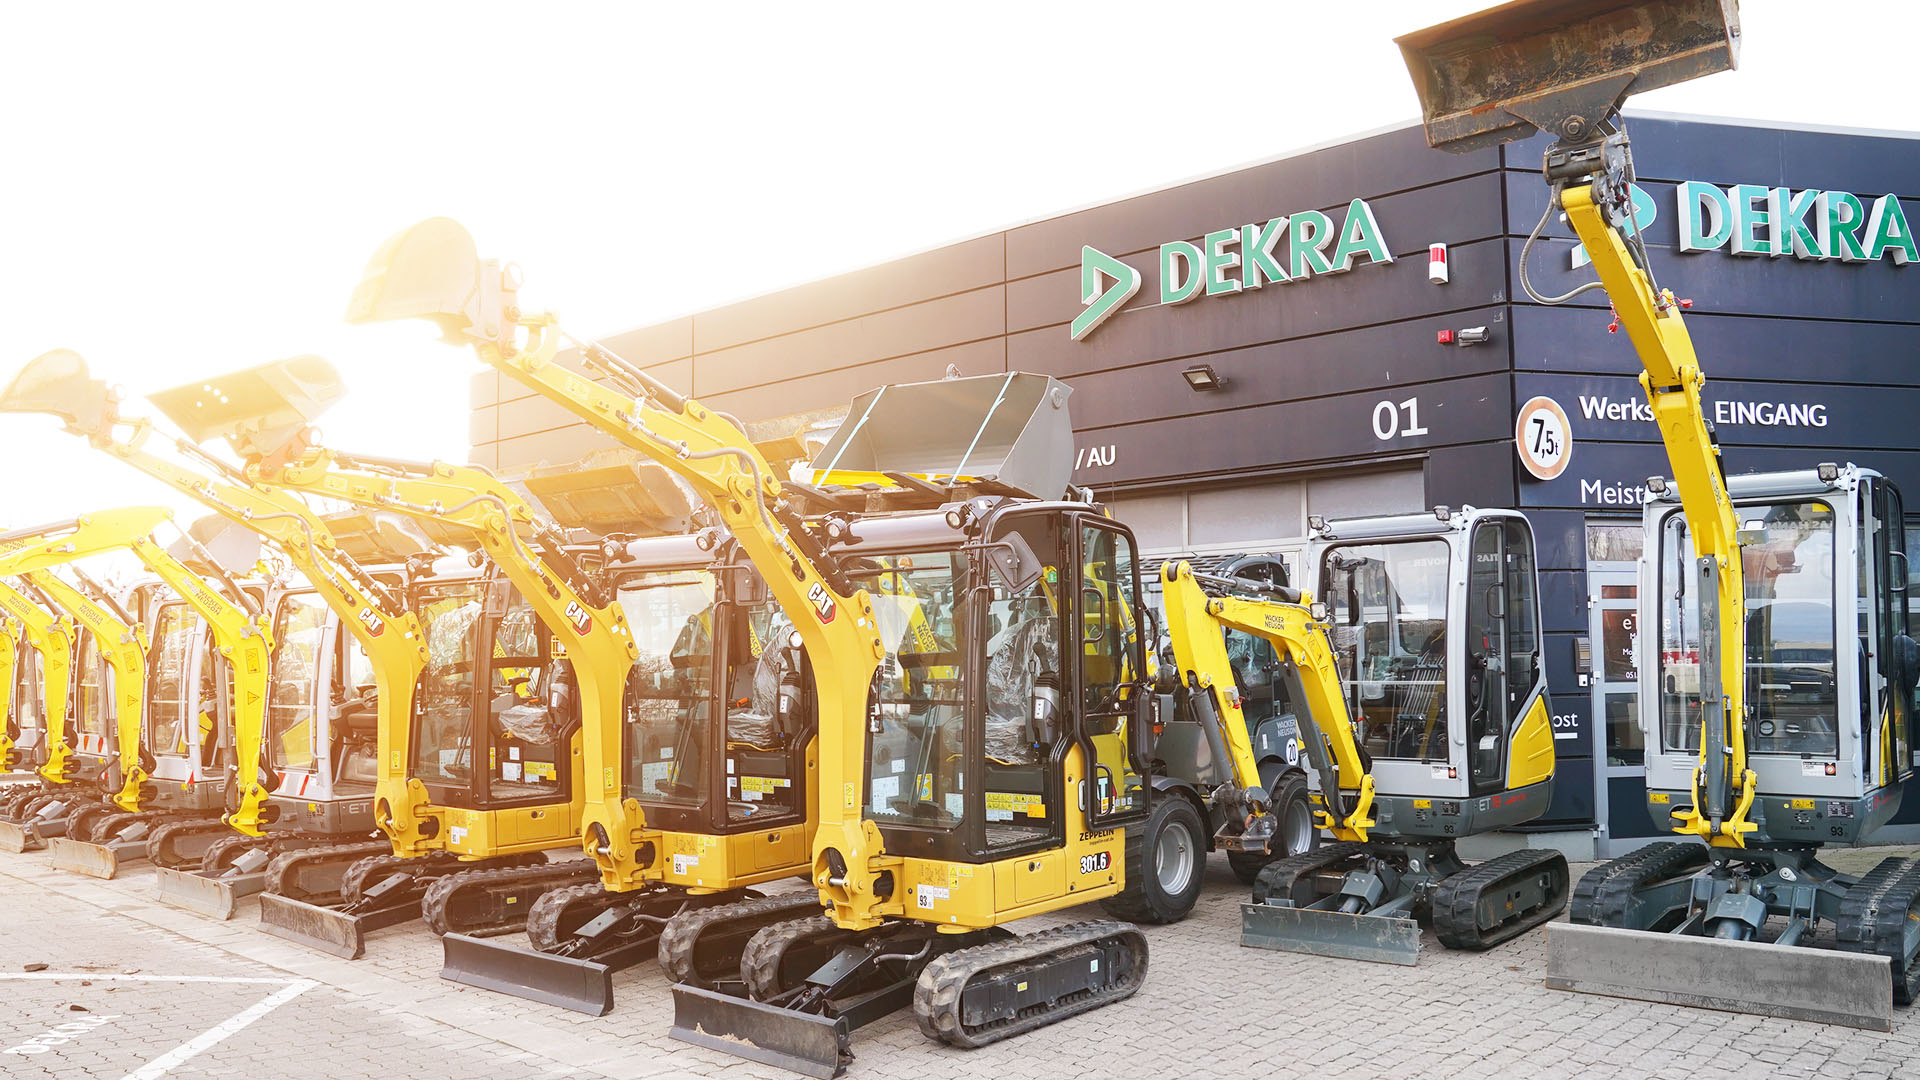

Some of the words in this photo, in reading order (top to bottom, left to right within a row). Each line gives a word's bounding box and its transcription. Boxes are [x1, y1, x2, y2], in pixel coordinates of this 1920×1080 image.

[1677, 180, 1919, 265] DEKRA
[1160, 198, 1393, 306] DEKRA
[1372, 397, 1428, 440] 01
[1578, 395, 1656, 422] Werks
[1714, 400, 1828, 427] EINGANG
[1580, 478, 1645, 505] Meist
[808, 582, 834, 615] CAT
[359, 607, 383, 631] CAT
[565, 600, 590, 629] CAT
[1553, 713, 1578, 727] ost
[1288, 743, 1297, 762] 20
[1080, 829, 1114, 841] ZEPPELIN
[1444, 824, 1455, 834] 93
[1830, 826, 1844, 837] 93
[1080, 852, 1107, 874] 301.6
[919, 895, 928, 906] 93
